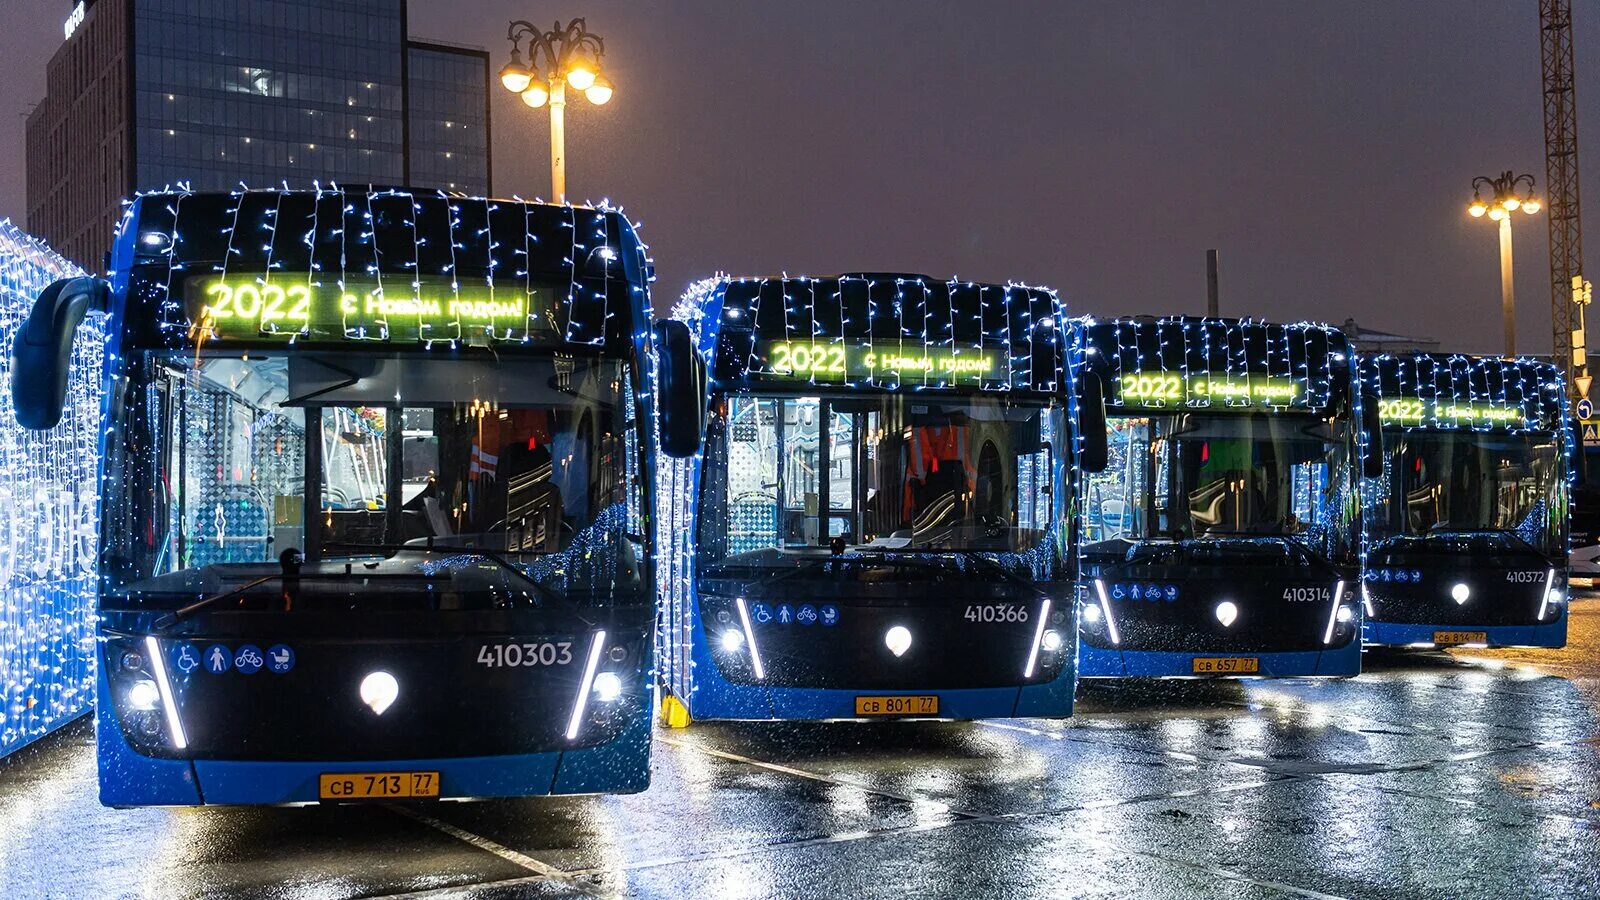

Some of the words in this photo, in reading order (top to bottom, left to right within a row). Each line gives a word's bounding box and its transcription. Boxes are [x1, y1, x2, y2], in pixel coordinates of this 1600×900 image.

[206, 283, 311, 319] 2022
[366, 294, 441, 316] Новым
[449, 298, 524, 318] годом!
[772, 346, 846, 372] 2022
[882, 353, 934, 370] Новым
[939, 357, 992, 371] годом!
[1123, 376, 1181, 398] 2022
[1378, 401, 1424, 419] 2022
[1506, 571, 1545, 583] 410372
[1282, 587, 1330, 602] 410314
[964, 605, 1029, 622] 410366
[477, 642, 573, 667] 410303
[1216, 659, 1237, 671] 657
[886, 698, 911, 712] 801
[920, 697, 934, 708] 77
[364, 776, 401, 795] 713
[413, 774, 432, 789] 77
